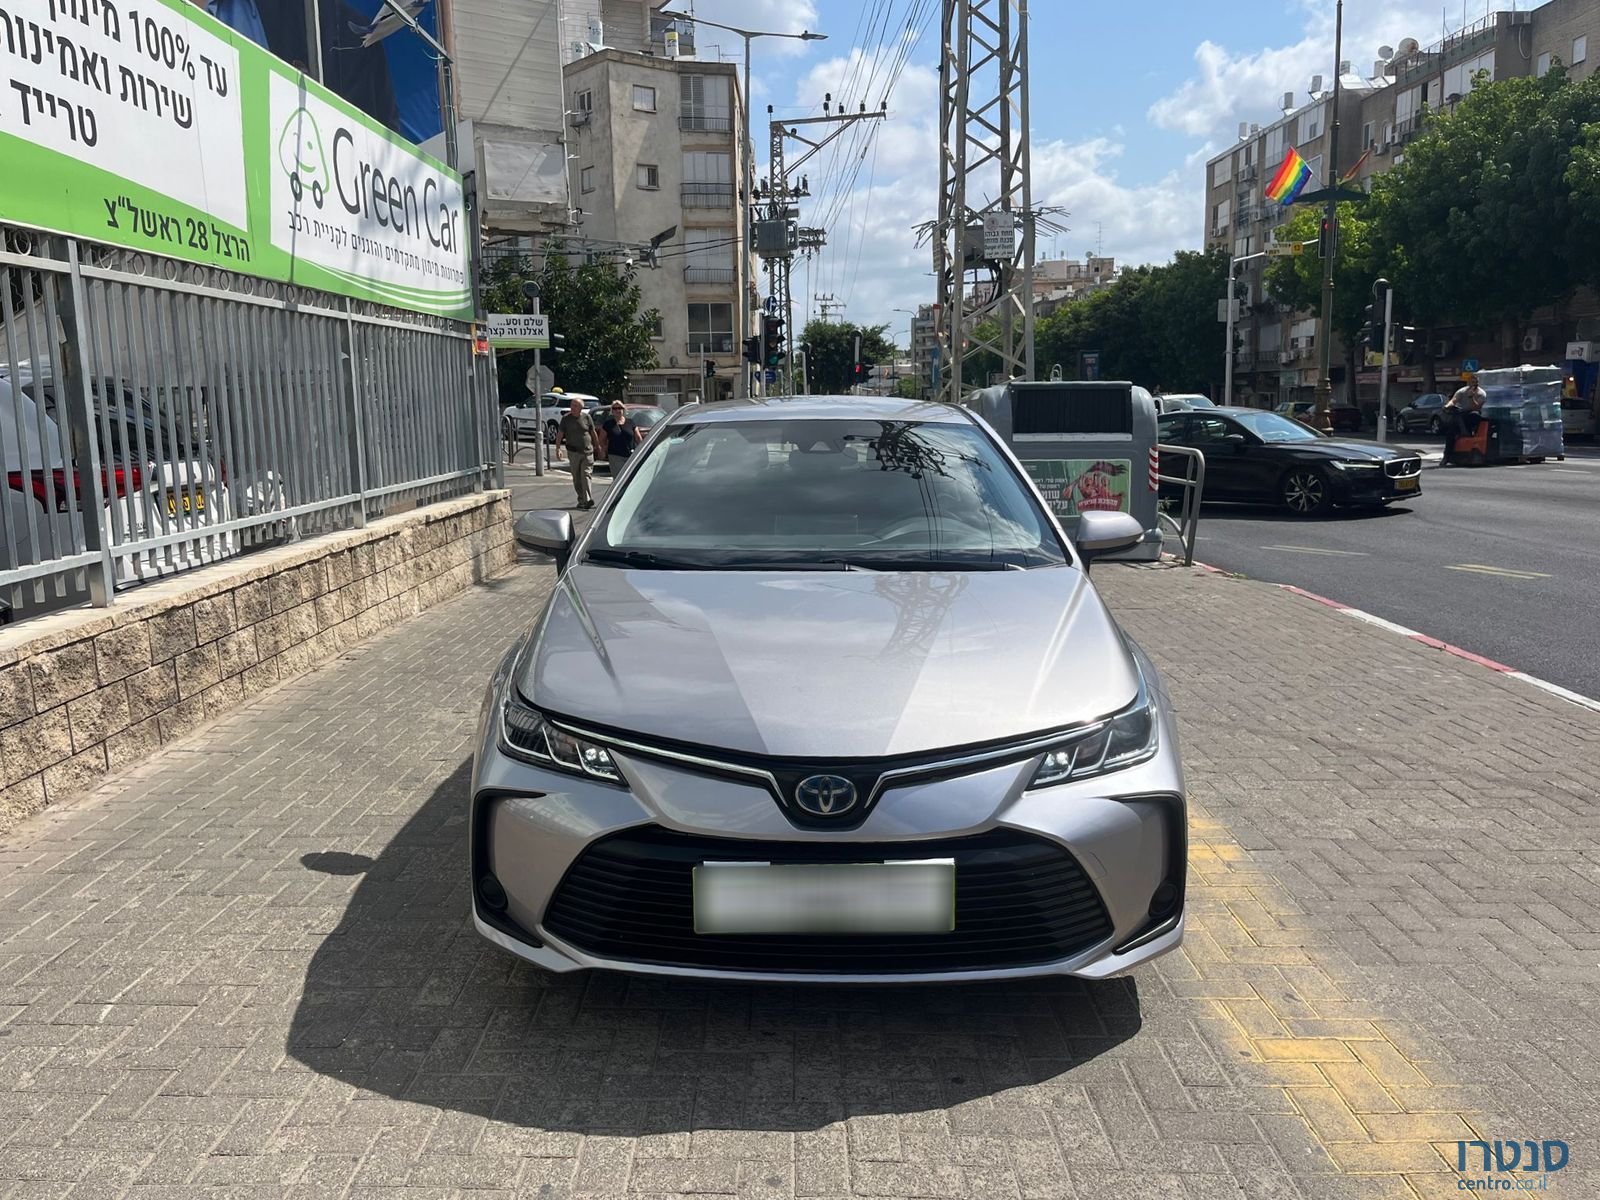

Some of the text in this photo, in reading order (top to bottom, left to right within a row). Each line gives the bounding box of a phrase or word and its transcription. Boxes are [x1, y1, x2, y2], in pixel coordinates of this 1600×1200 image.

[129, 10, 196, 81] 100%
[200, 54, 228, 98] עד
[10, 78, 98, 148] טרייד
[118, 64, 193, 130] שירות
[332, 127, 459, 255] Green Car
[185, 216, 209, 251] 28
[287, 210, 310, 235] רכב
[313, 218, 348, 249] לקניית
[211, 223, 251, 263] הרצל
[351, 233, 383, 259] והוגנים
[385, 245, 420, 272] מתקדמים
[422, 257, 440, 276] מימון
[520, 327, 543, 335] אצלנו
[524, 317, 543, 326] שלם
